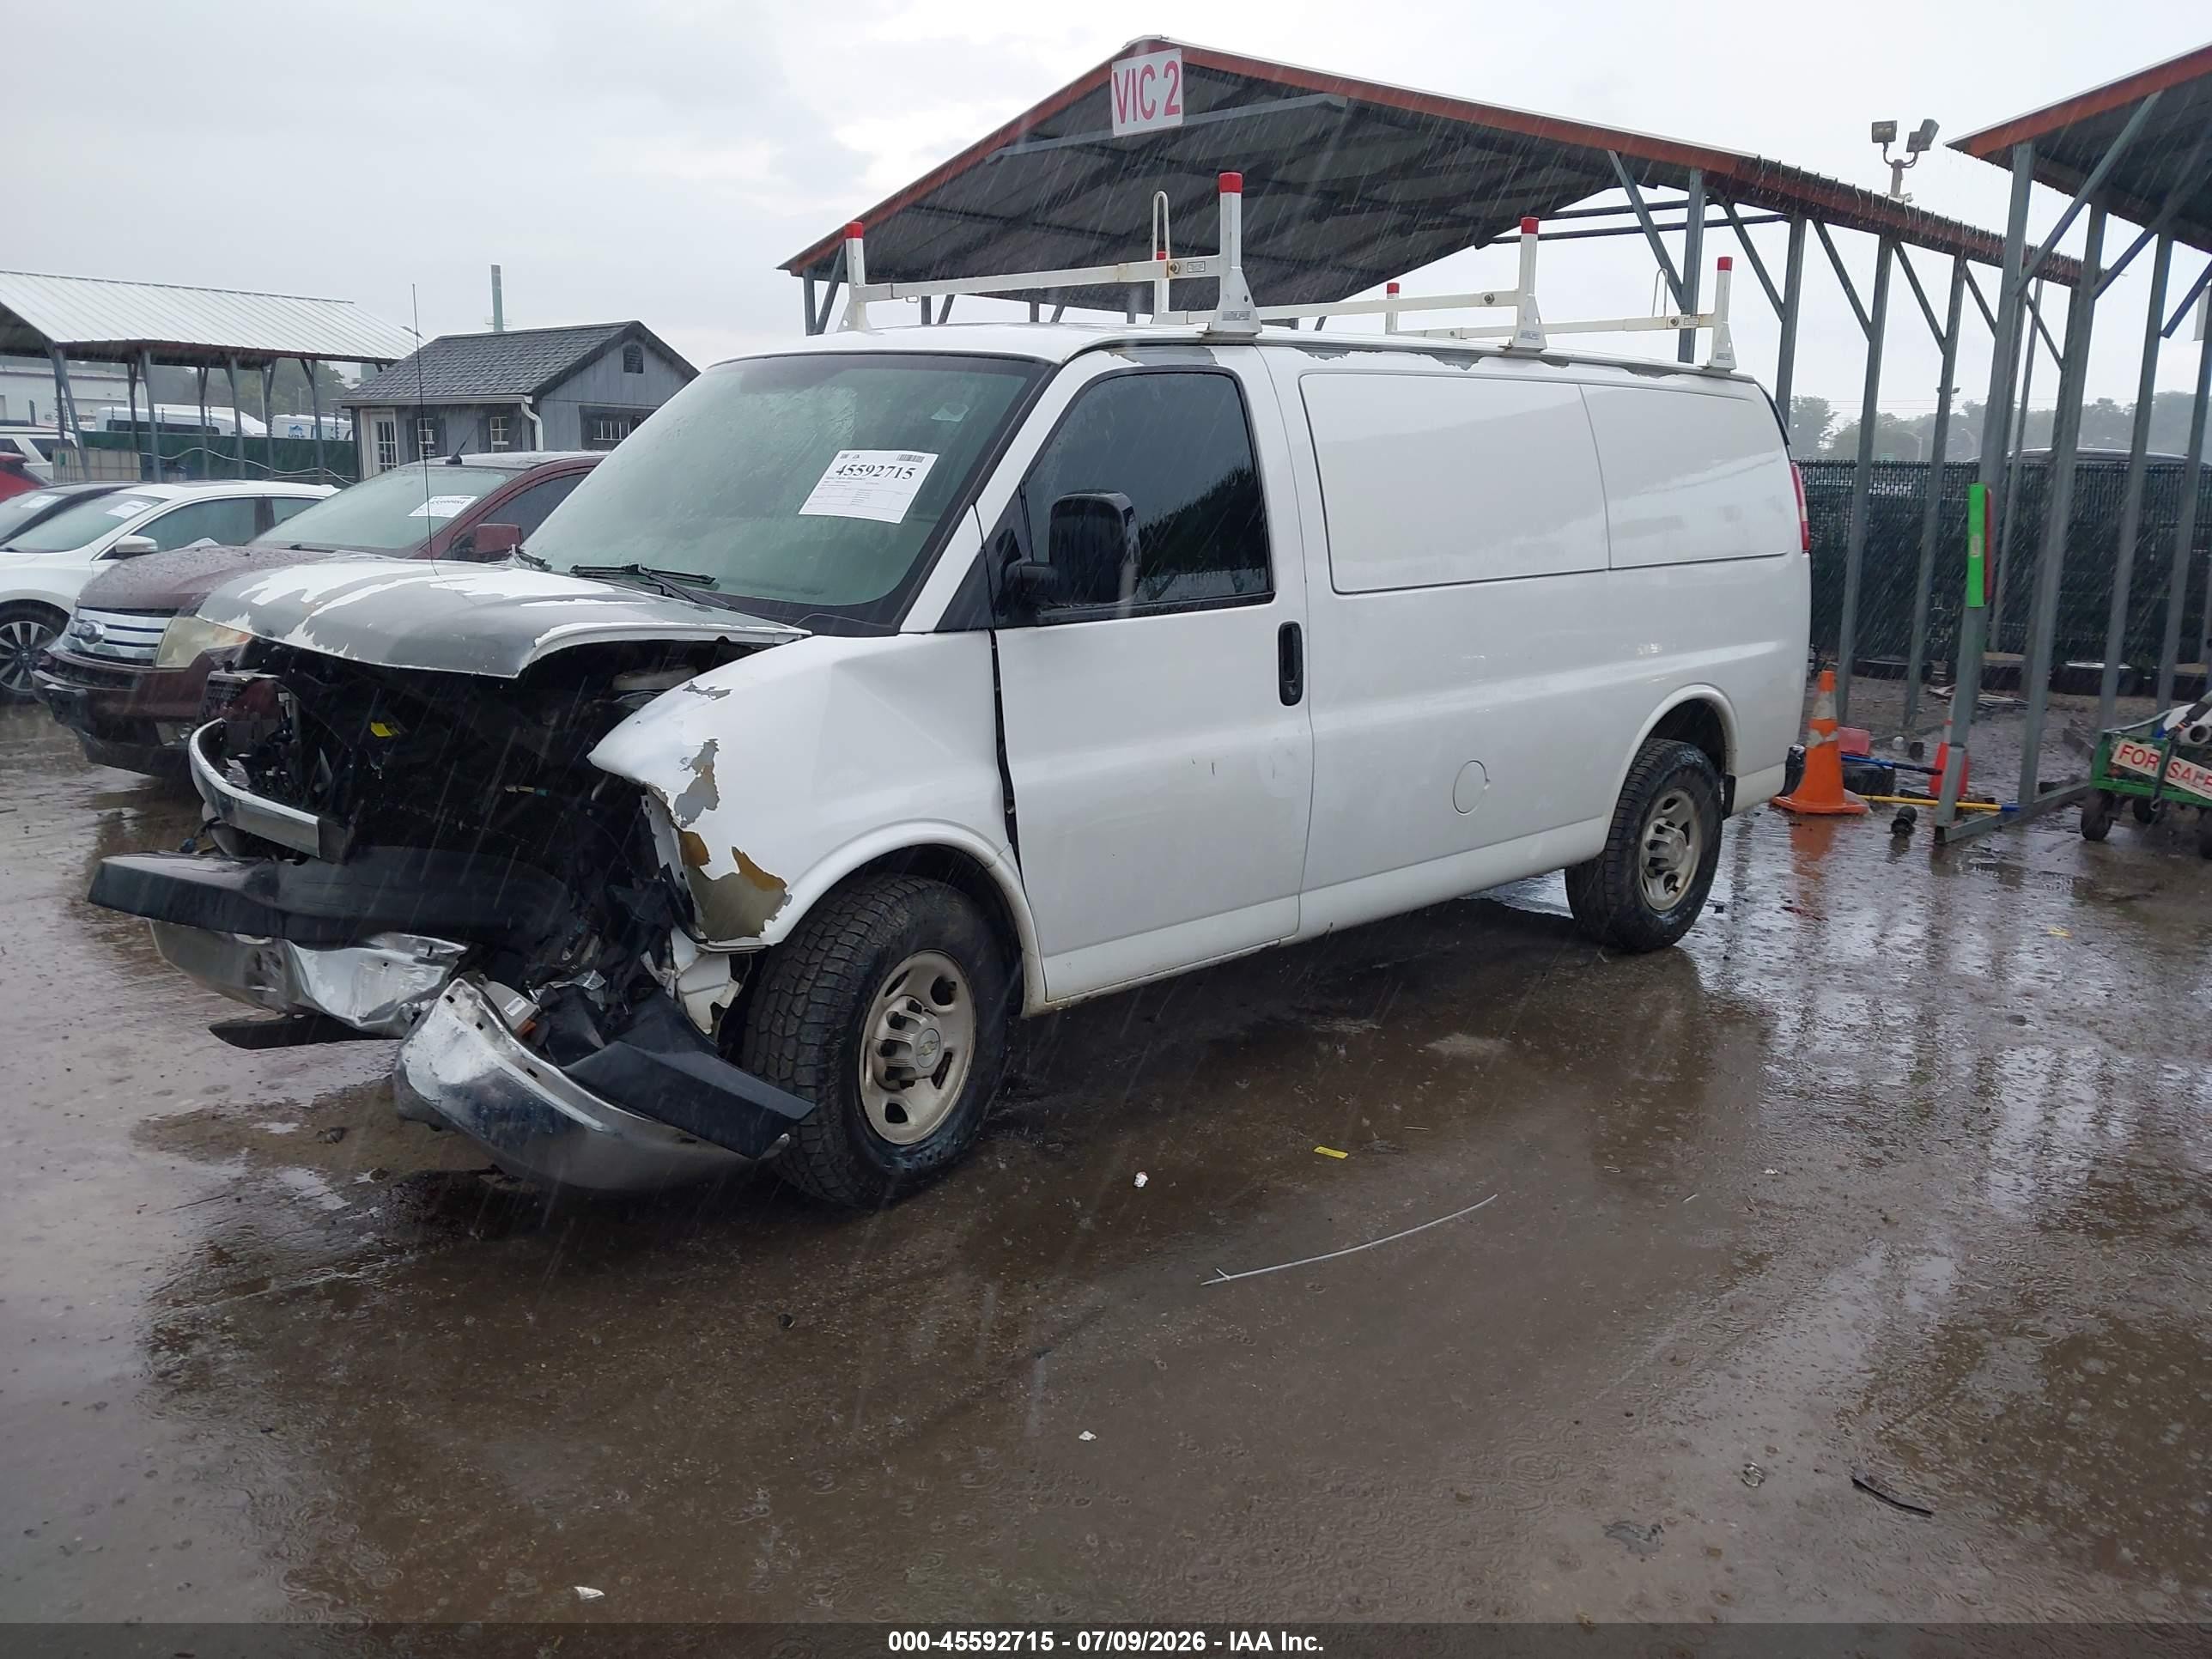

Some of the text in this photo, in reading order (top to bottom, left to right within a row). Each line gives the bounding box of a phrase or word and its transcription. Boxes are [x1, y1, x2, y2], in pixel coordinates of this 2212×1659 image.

[1113, 60, 1181, 125] VIC 2
[836, 464, 916, 479] 45592715
[2118, 744, 2161, 771] FOR
